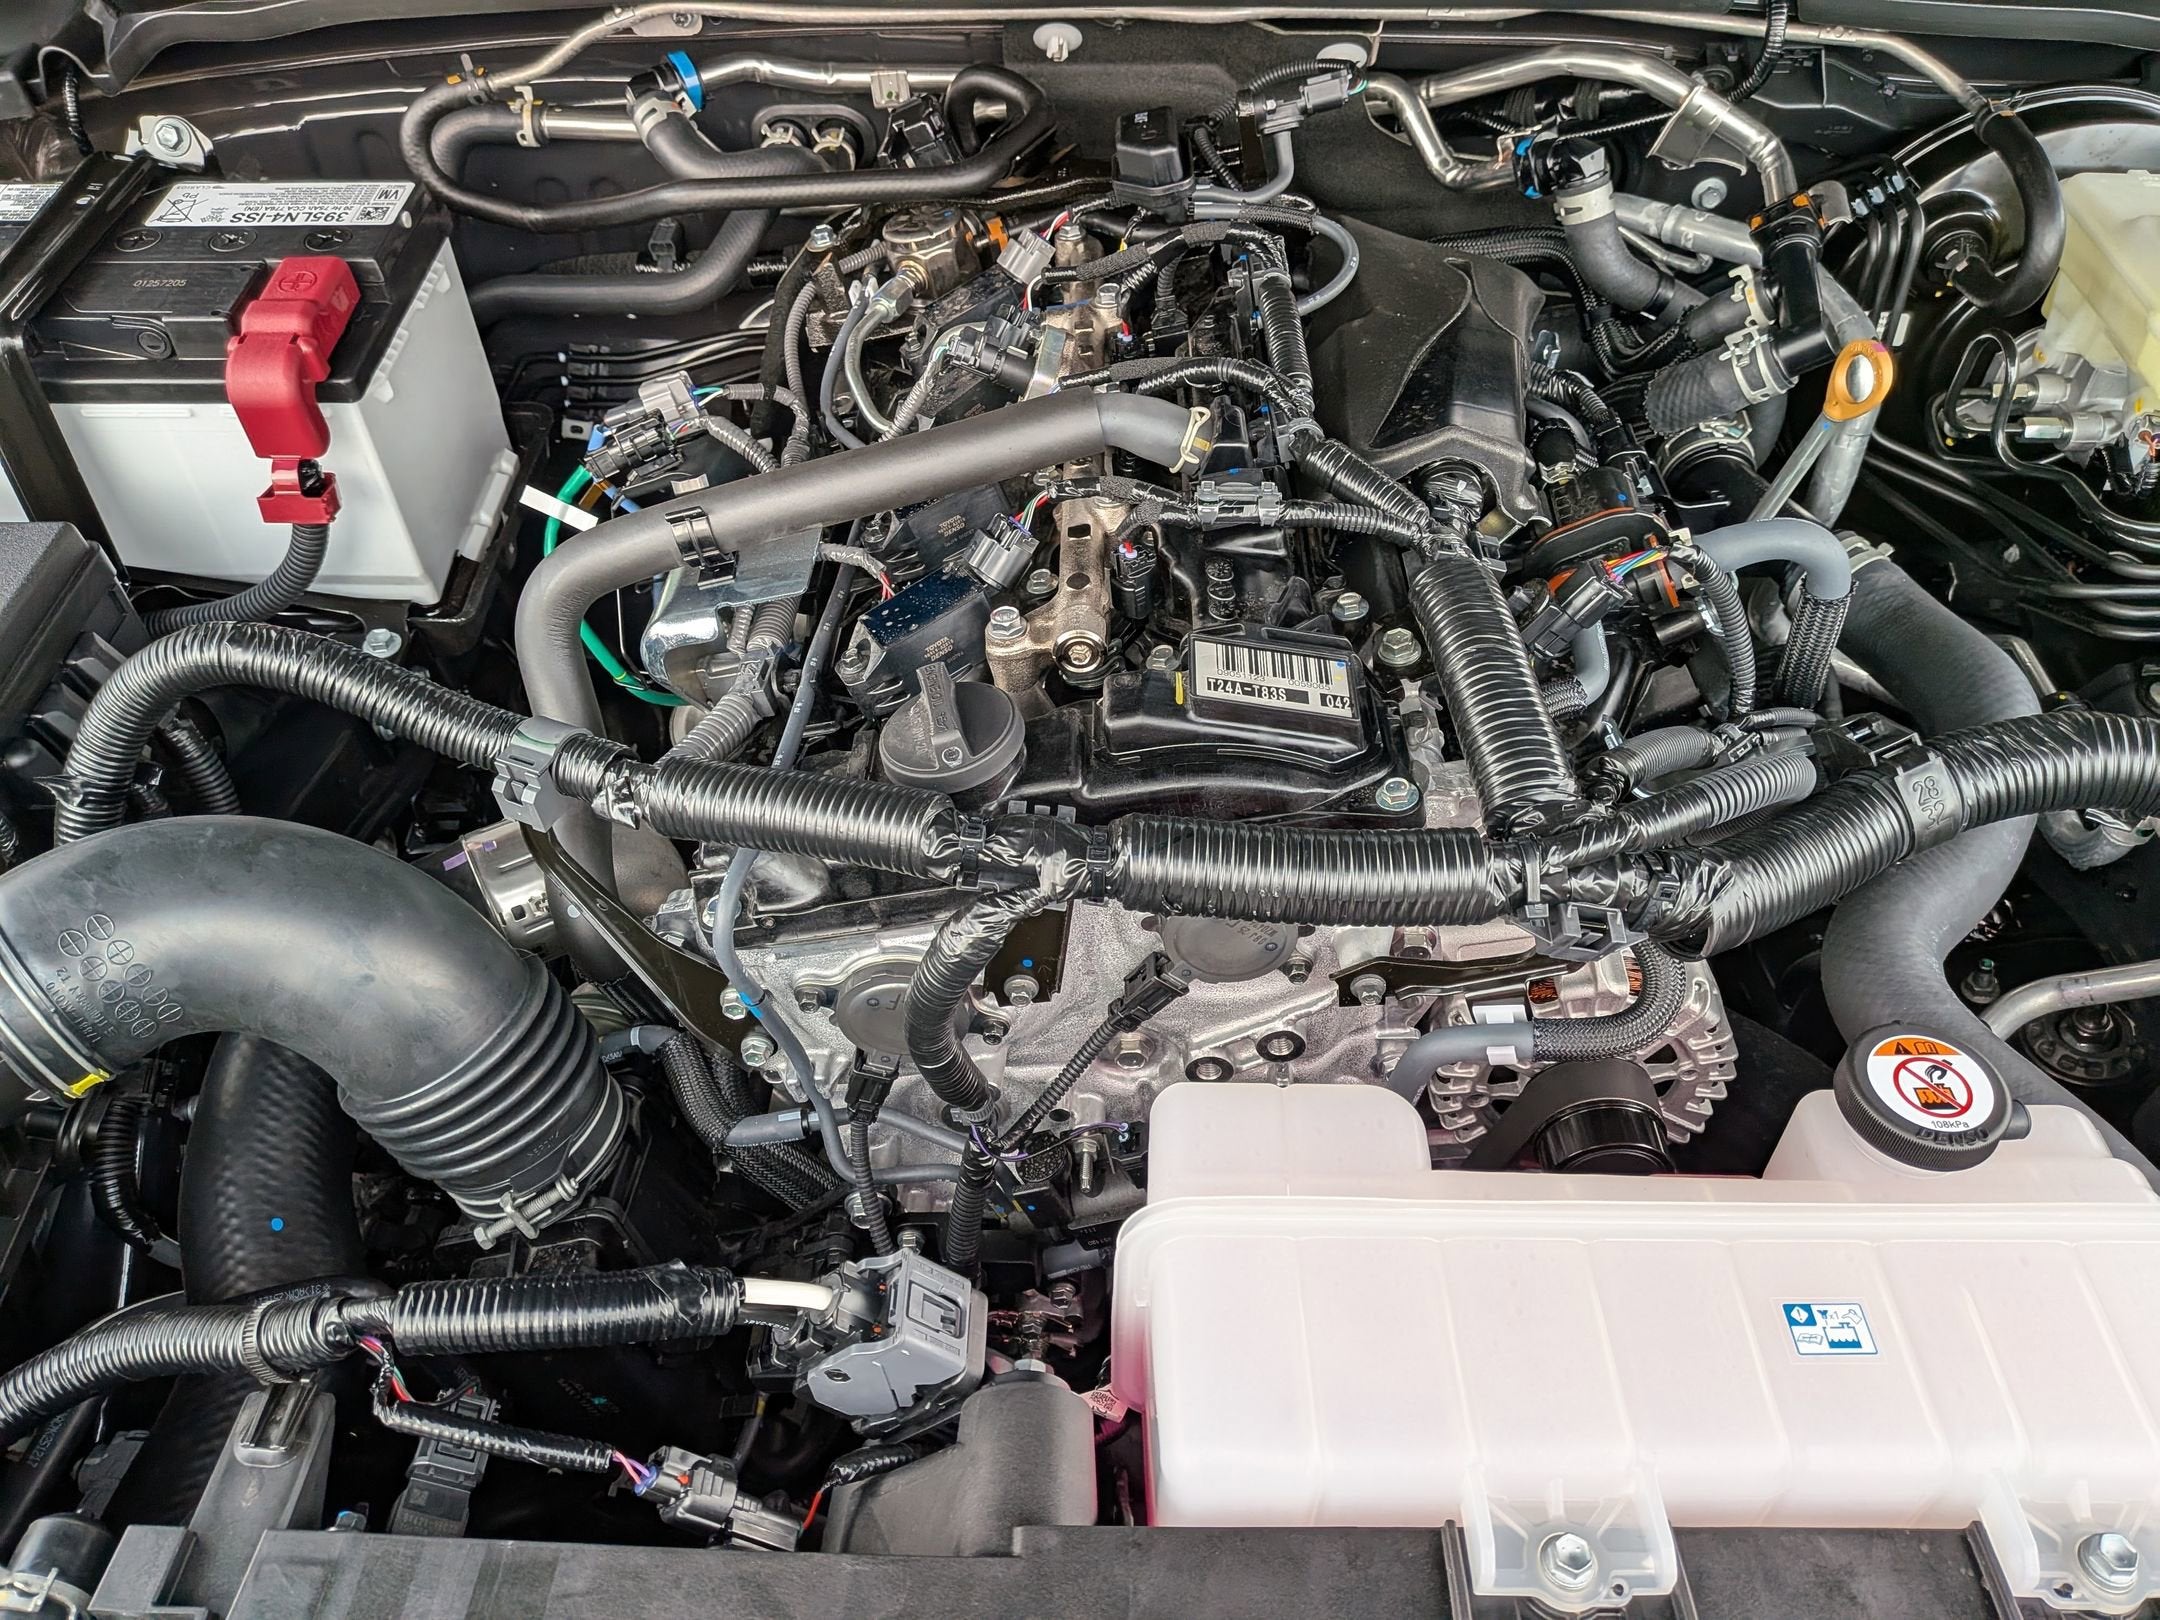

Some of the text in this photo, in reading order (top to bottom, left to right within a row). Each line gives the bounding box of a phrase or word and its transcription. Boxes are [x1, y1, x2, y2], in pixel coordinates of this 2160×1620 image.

[378, 189, 400, 200] VM
[229, 211, 349, 224] 395LN4-ISS
[938, 514, 962, 528] TOYOTA
[943, 523, 965, 537] DENSO
[924, 636, 949, 652] TOYOTA
[930, 646, 953, 662] DENSO
[1208, 678, 1350, 709] T24A-T83S 042
[1912, 775, 1940, 806] 28
[1921, 800, 1953, 830] 32
[1931, 1120, 1970, 1129] 108kPa
[1916, 1127, 1990, 1147] DENSO
